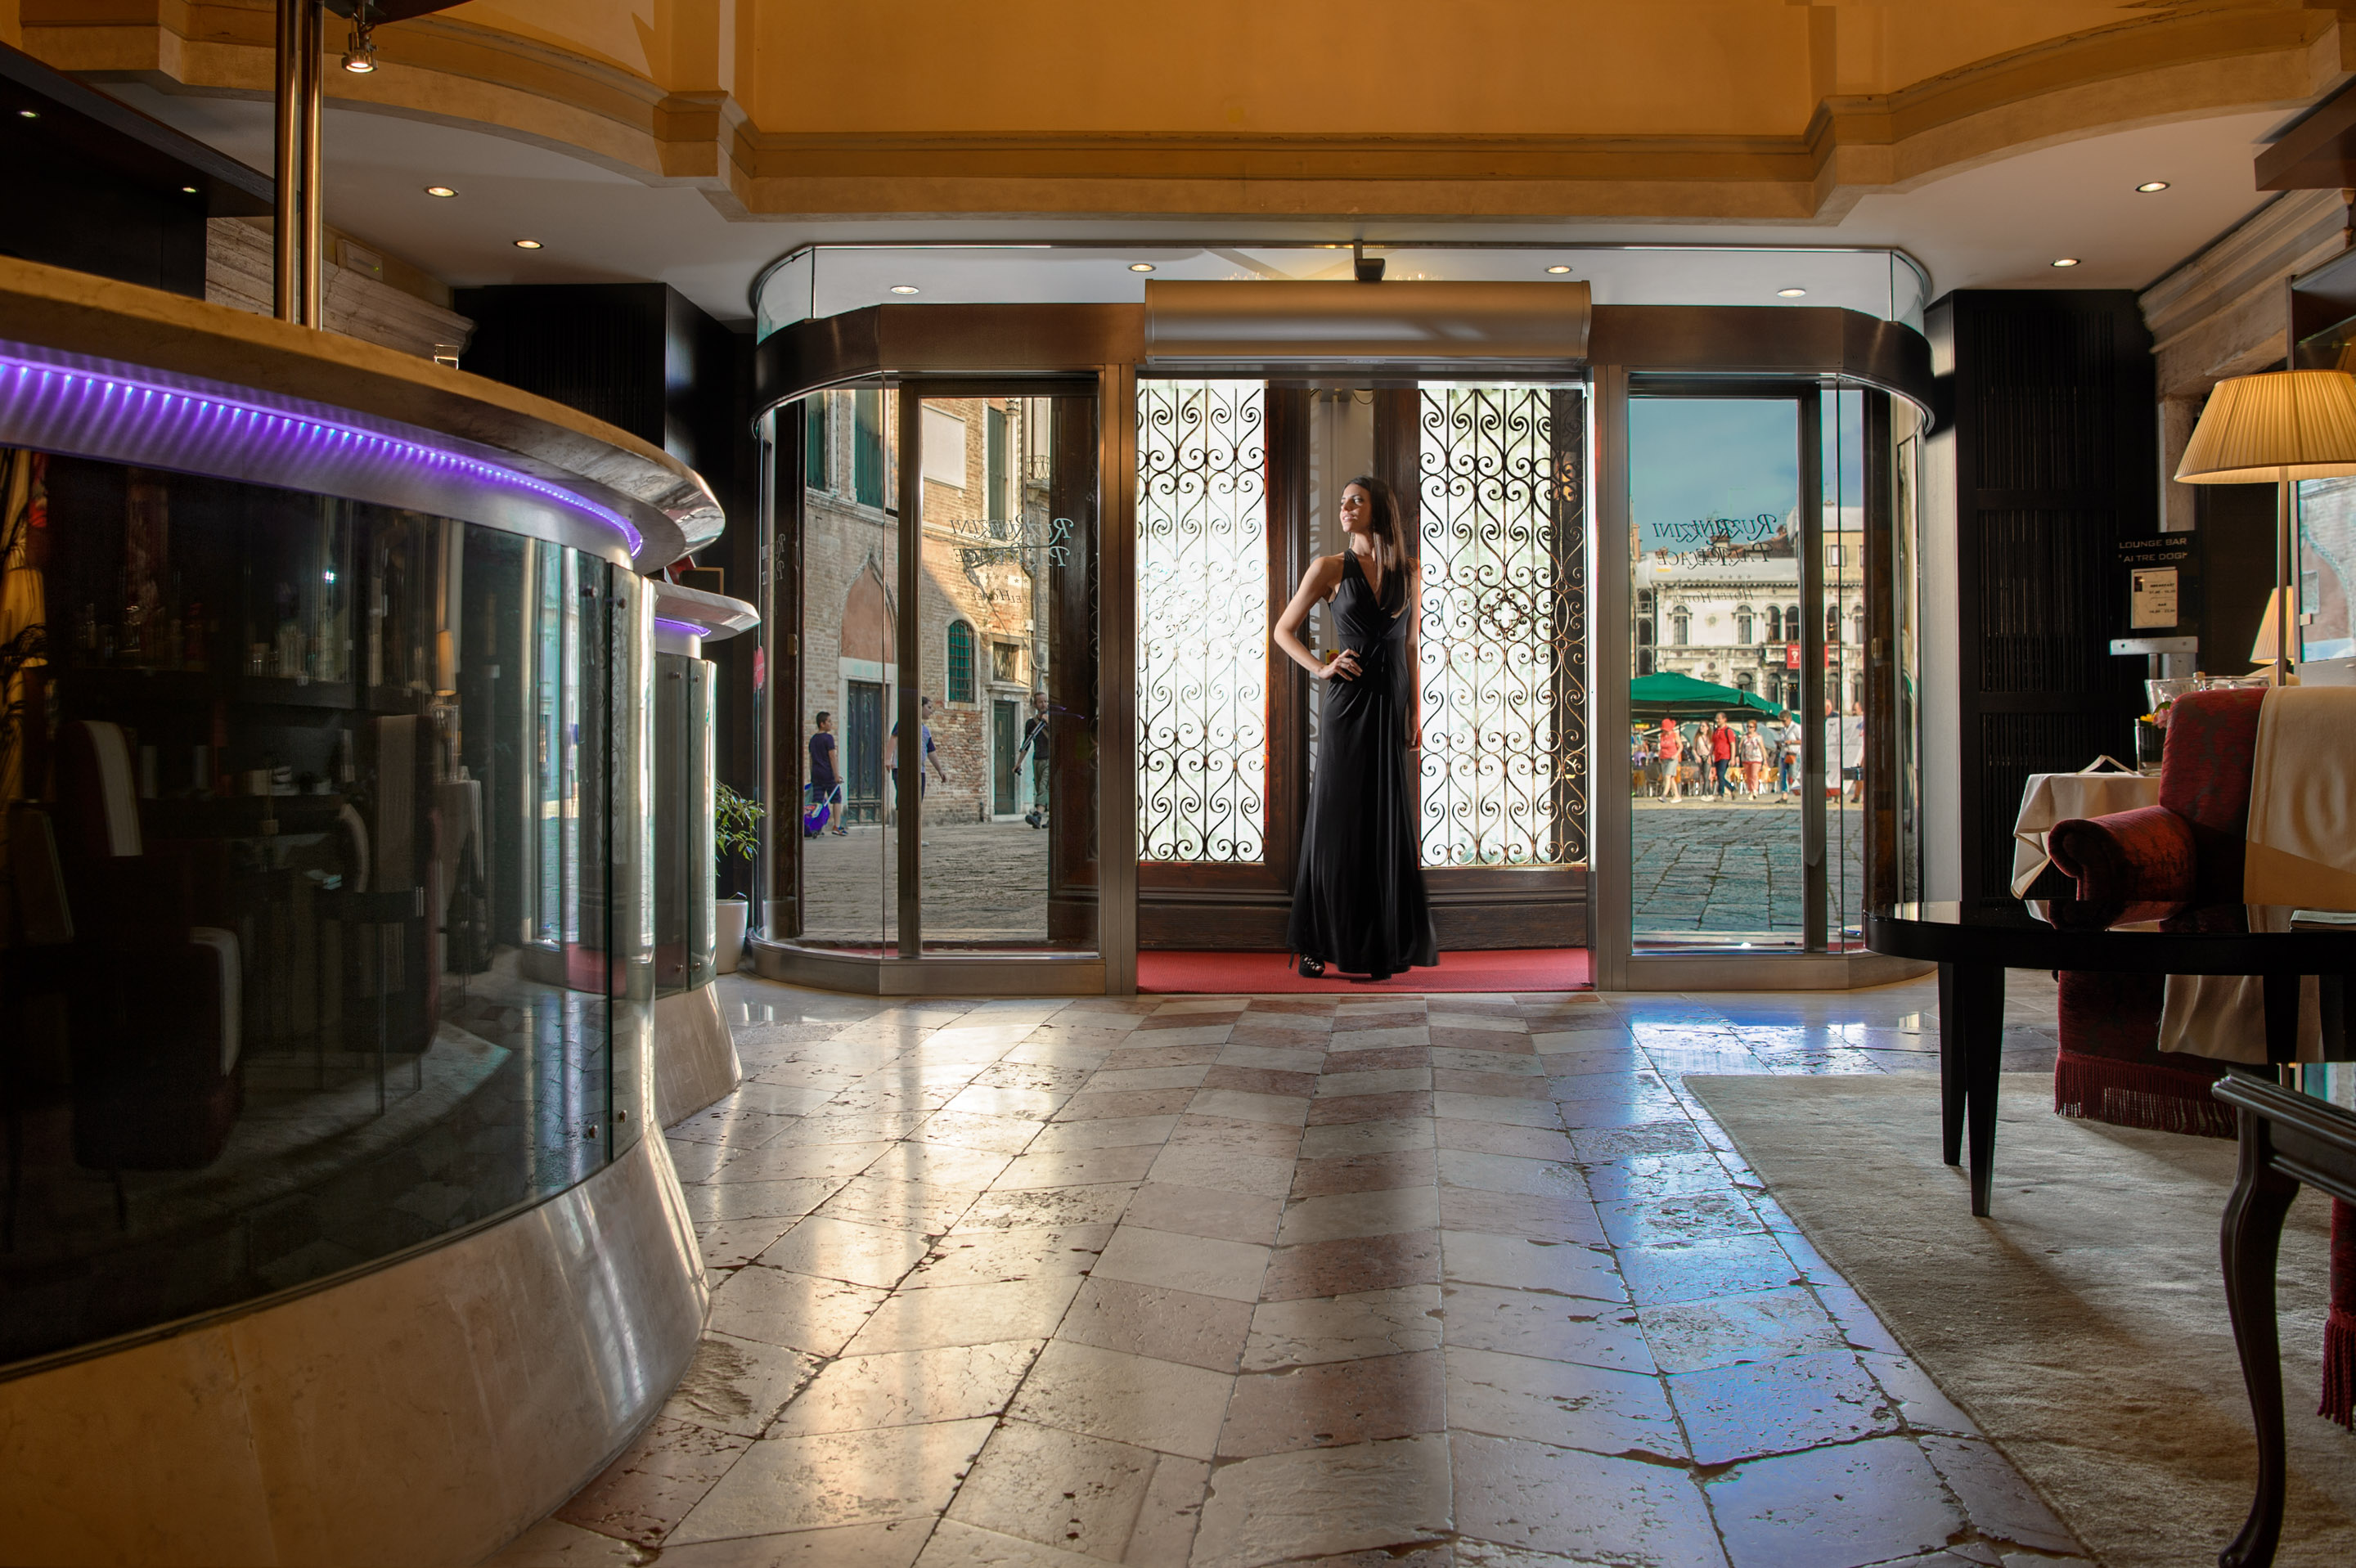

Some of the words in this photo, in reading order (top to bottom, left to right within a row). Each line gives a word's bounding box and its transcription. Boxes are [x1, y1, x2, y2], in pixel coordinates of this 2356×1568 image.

[2119, 540, 2162, 549] LOUNGE
[2165, 537, 2187, 546] BAR
[2135, 554, 2156, 562] TRE
